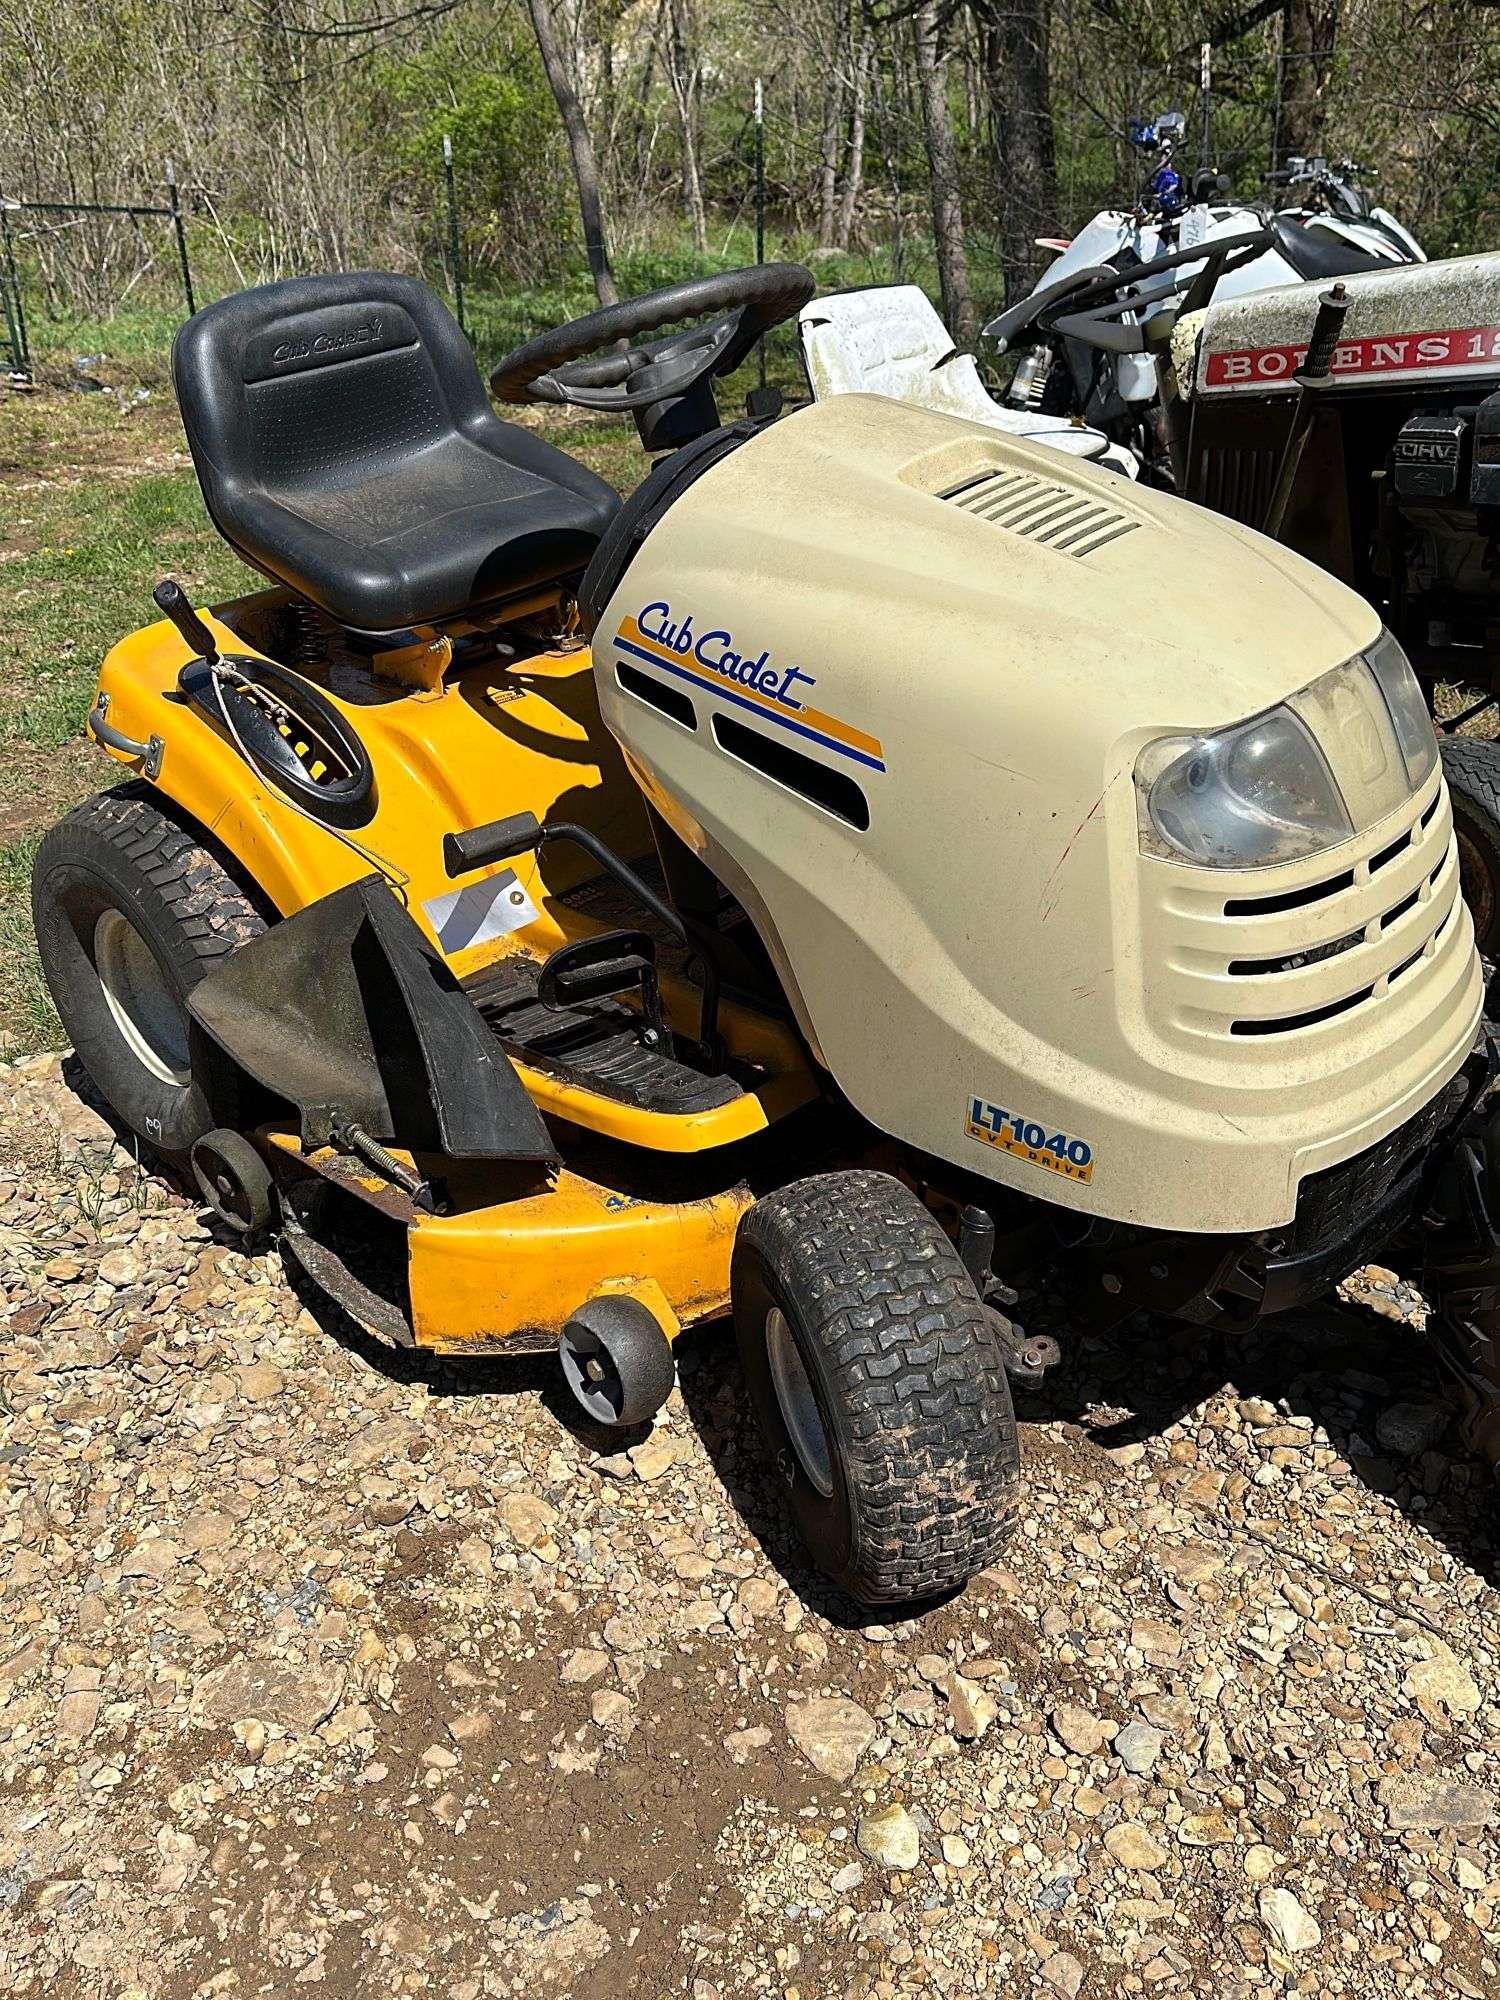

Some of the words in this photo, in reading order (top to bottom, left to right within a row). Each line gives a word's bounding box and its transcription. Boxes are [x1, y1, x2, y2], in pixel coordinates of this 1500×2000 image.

[272, 341, 310, 363] Cub
[1223, 337, 1450, 379] BOENS
[1402, 443, 1450, 458] OHV
[637, 601, 693, 655] Cub
[695, 630, 817, 710] Cadet
[970, 1126, 1015, 1150] CVT
[1028, 1150, 1087, 1179] DRIVE
[972, 1099, 1092, 1166] LT1040
